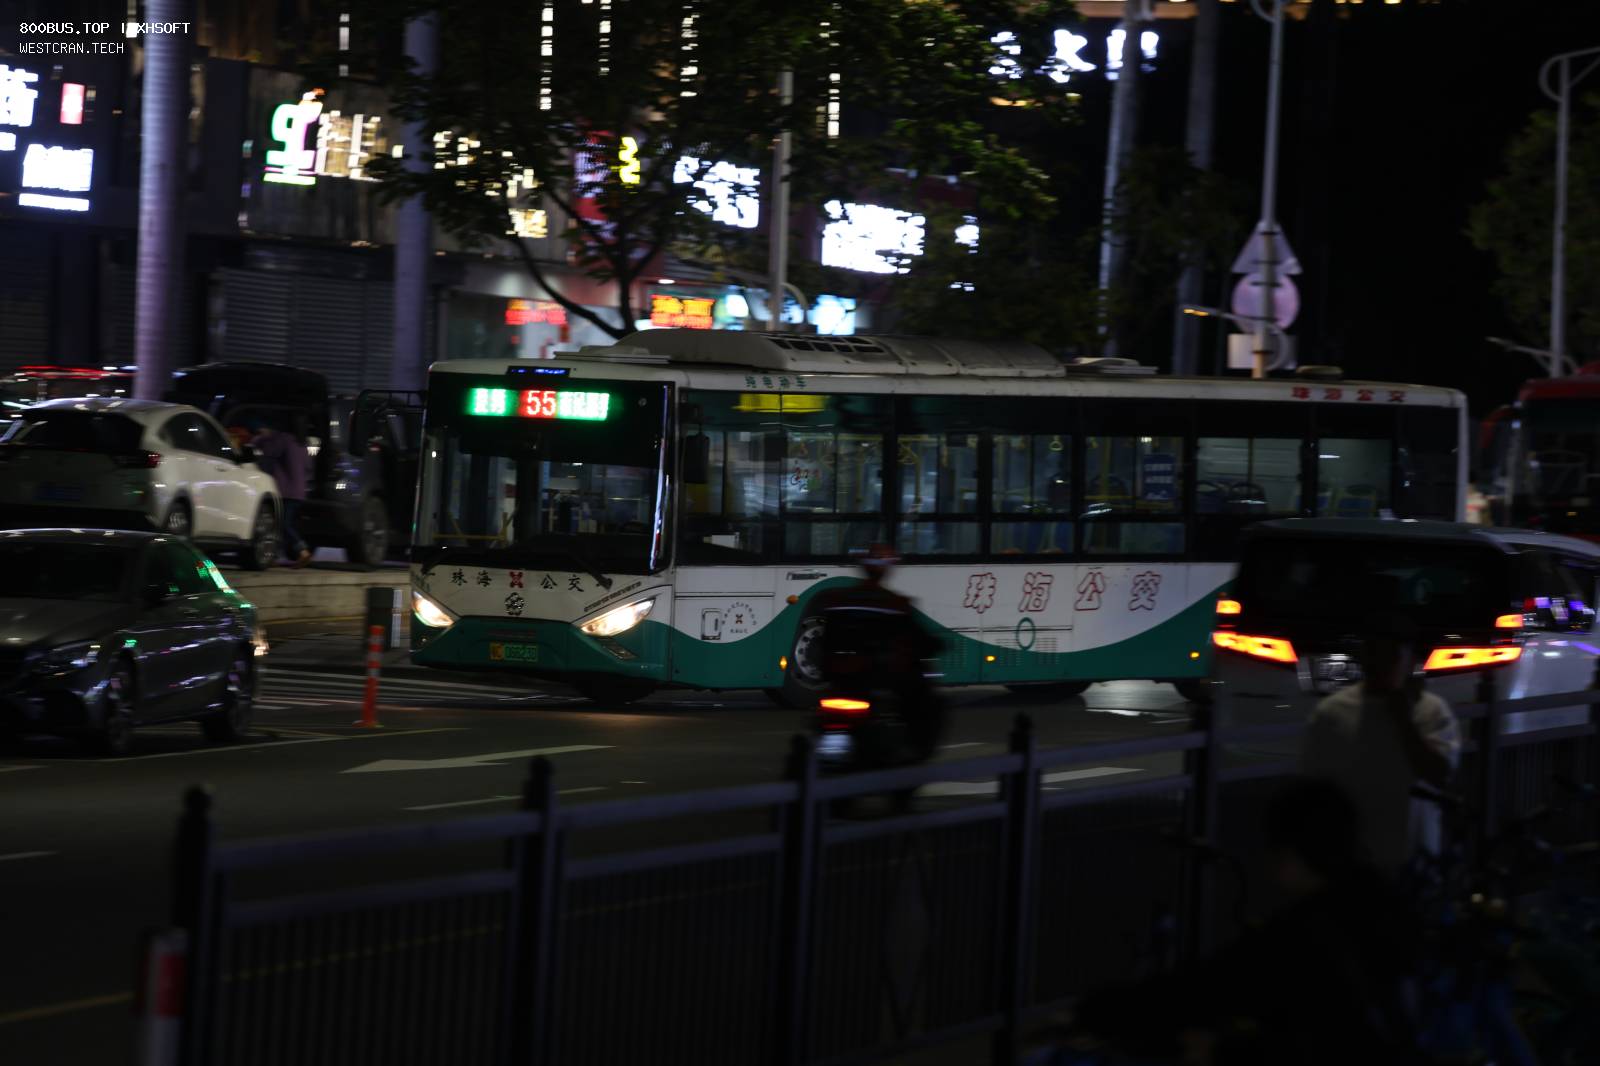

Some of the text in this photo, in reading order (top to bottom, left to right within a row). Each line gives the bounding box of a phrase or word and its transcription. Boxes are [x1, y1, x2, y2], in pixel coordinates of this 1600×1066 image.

[526, 390, 557, 416] 55
[452, 568, 585, 593] 珠海 公交
[963, 571, 1162, 614] 珠海公交
